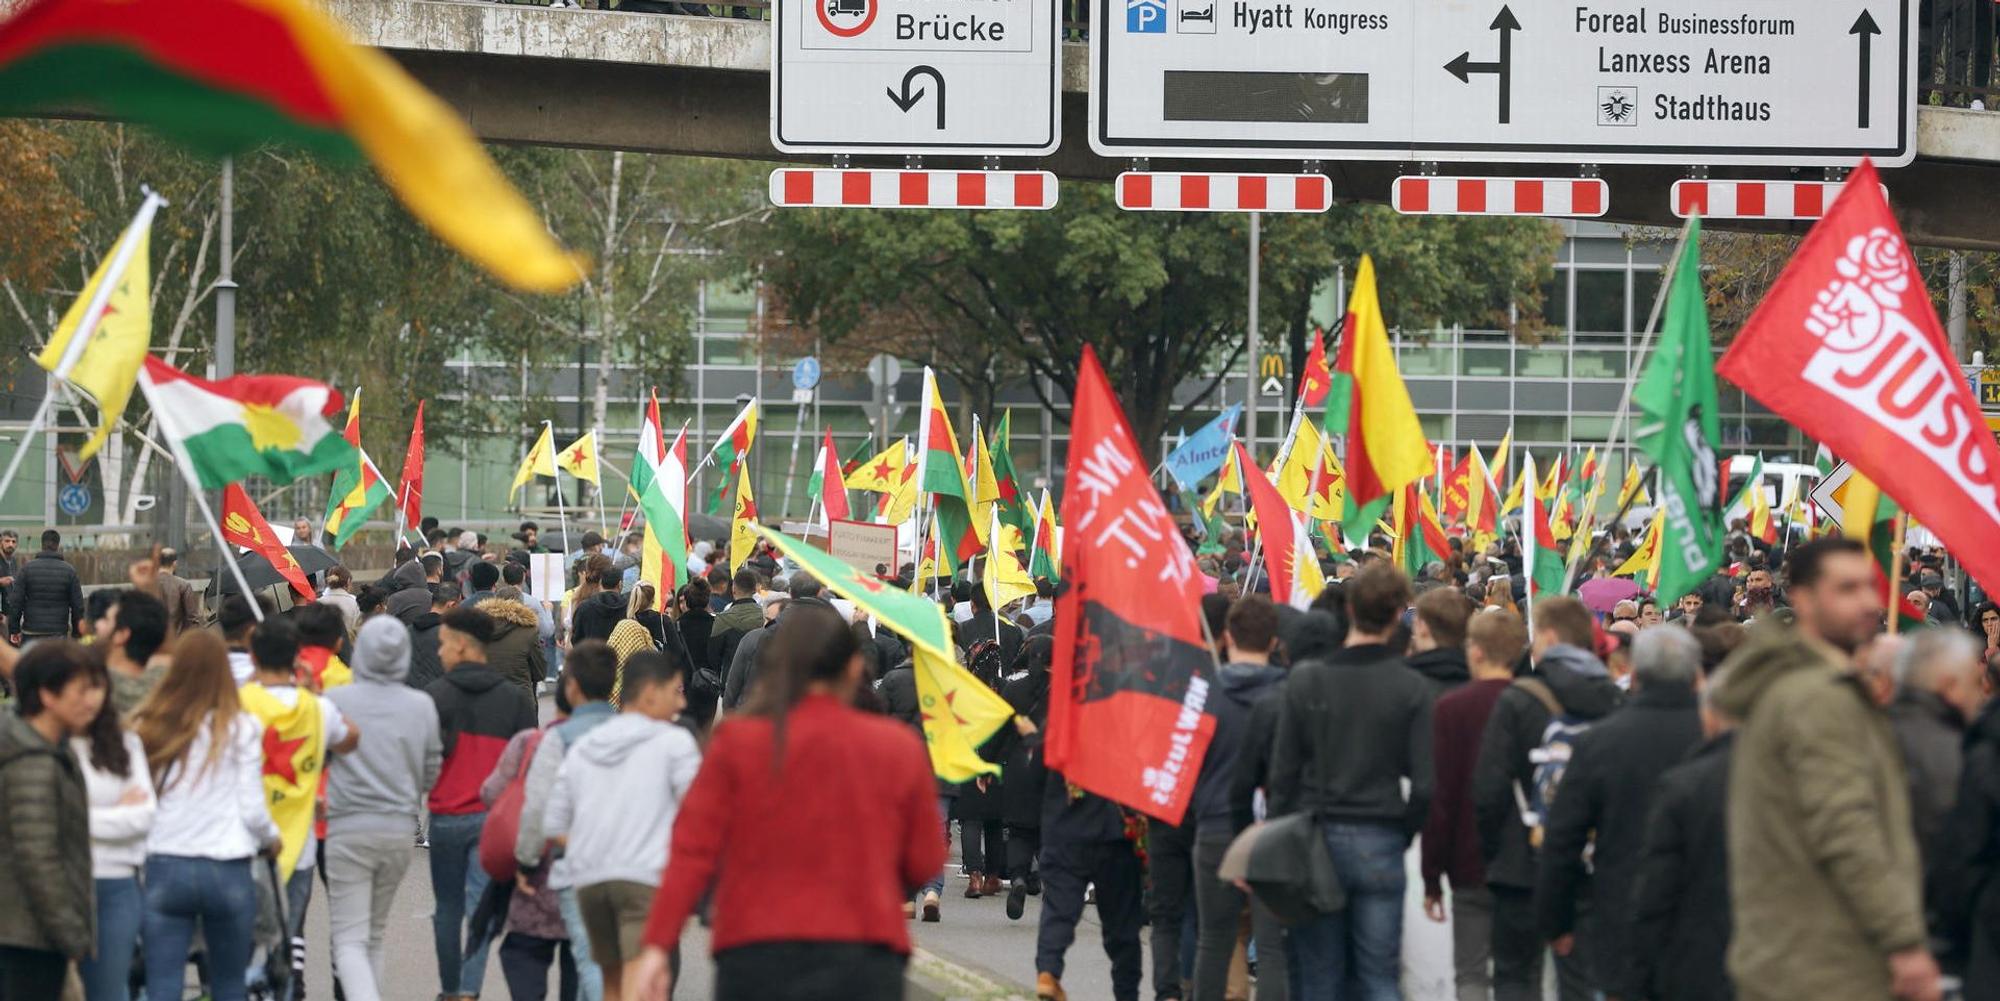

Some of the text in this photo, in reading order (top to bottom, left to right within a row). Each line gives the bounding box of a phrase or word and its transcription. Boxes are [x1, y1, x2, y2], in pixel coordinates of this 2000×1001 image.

[896, 14, 1005, 41] Brücke
[1233, 2, 1389, 35] Hyatt Kongress
[1575, 7, 1795, 36] Foreal Businessforum
[1599, 46, 1771, 75] Lanxess Arena
[1655, 94, 1771, 121] Stadthaus
